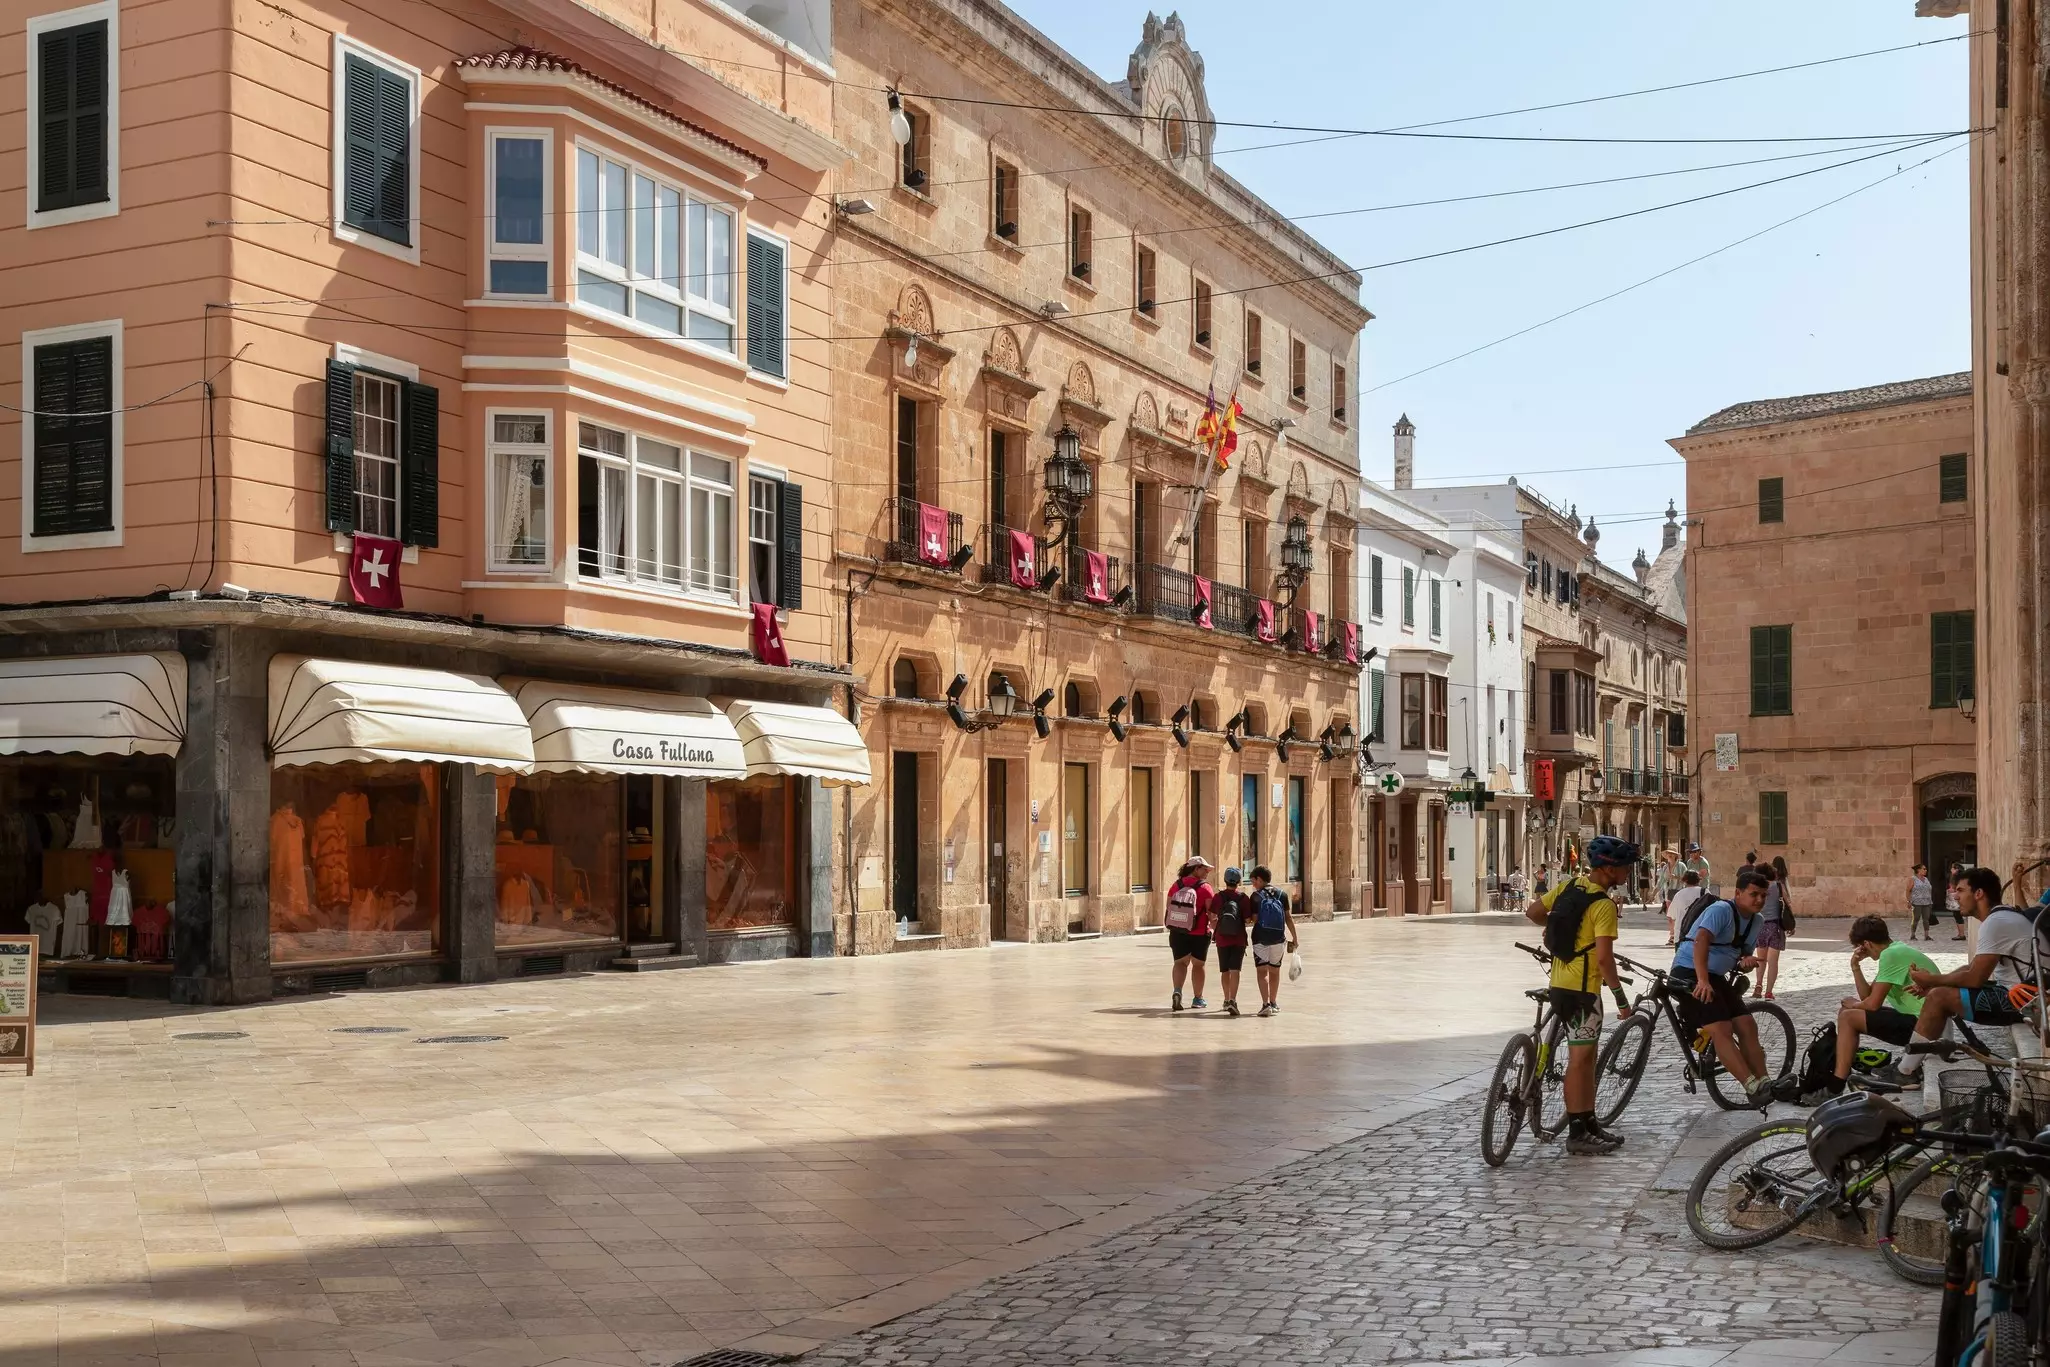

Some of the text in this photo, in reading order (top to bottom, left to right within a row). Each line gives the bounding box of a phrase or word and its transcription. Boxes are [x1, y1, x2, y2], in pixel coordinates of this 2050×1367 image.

[612, 738, 715, 762] Casa Fullana
[1538, 763, 1550, 797] MITIK
